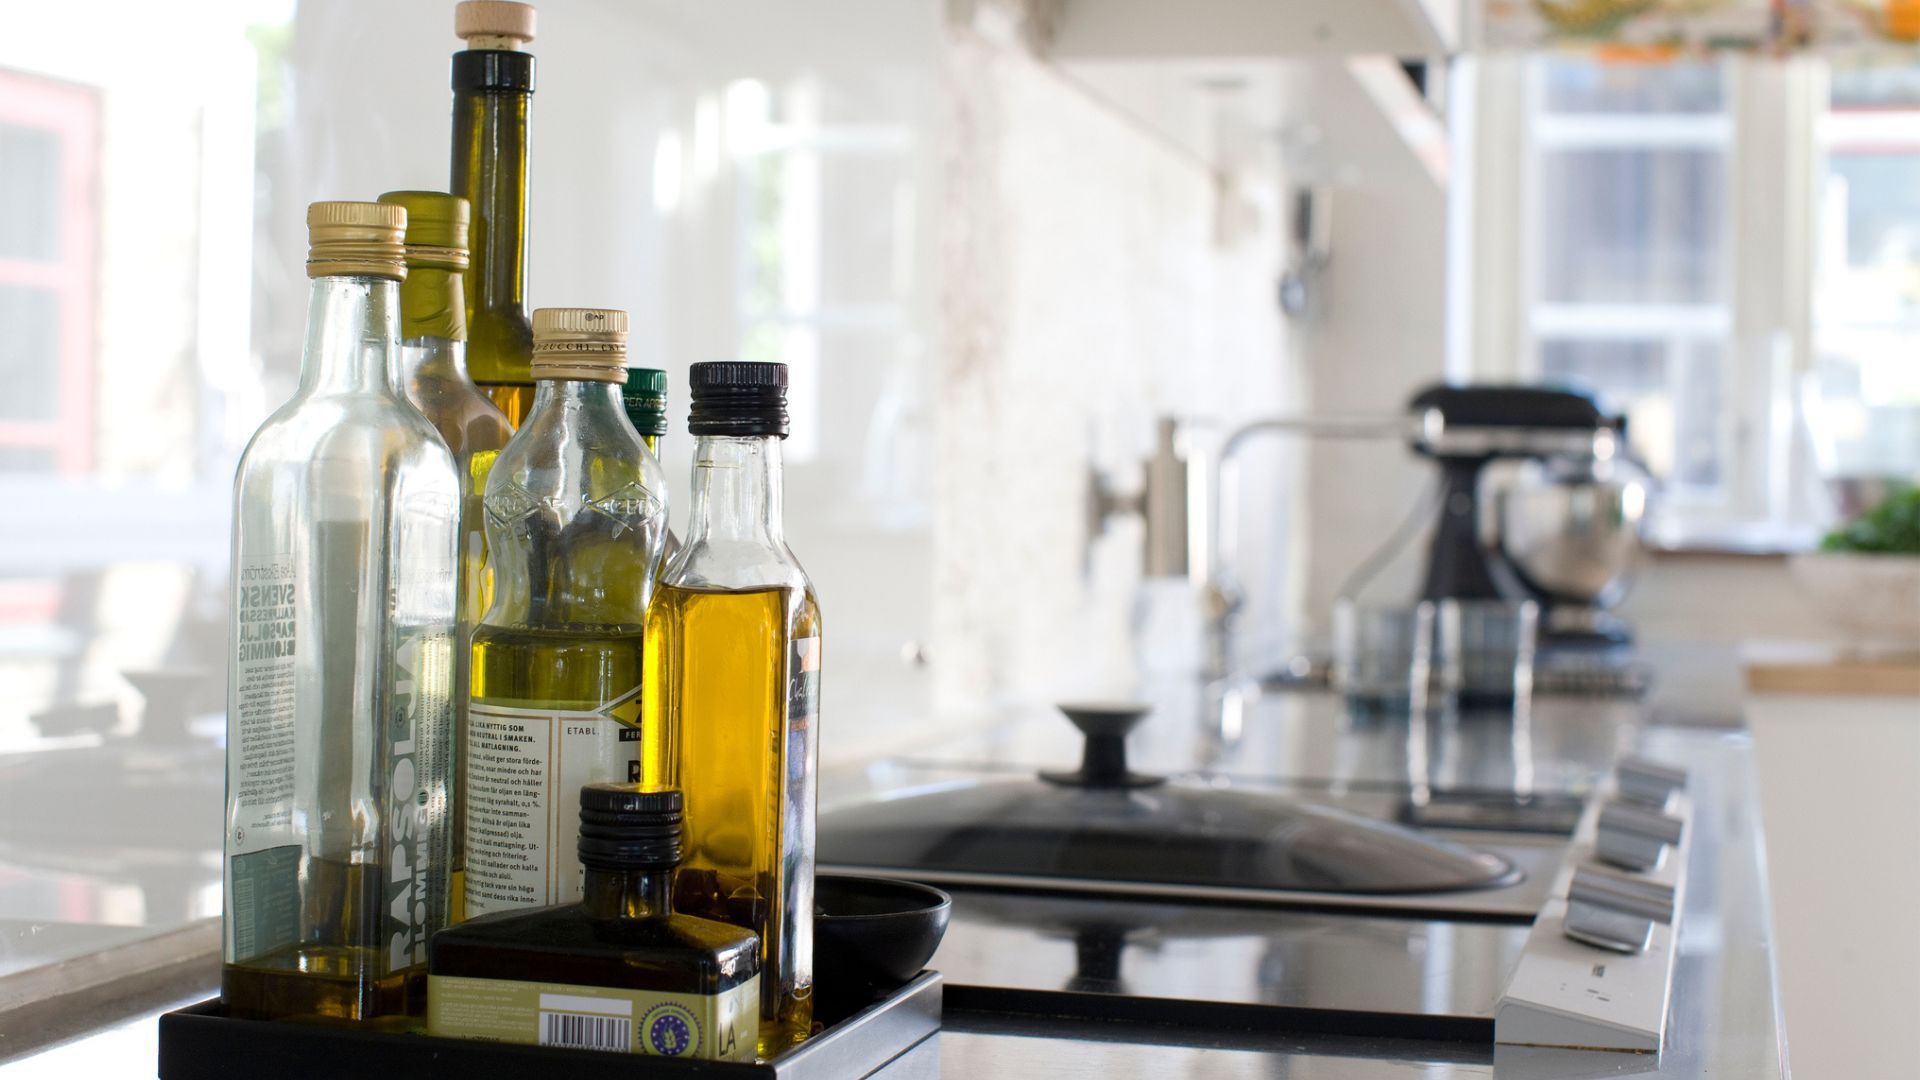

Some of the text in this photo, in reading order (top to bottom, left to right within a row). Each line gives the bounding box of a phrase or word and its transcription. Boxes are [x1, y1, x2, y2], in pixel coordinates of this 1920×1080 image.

[486, 723, 507, 731] NYTTIG
[477, 732, 498, 740] NEUTRAL
[482, 743, 521, 752] MATLAGNING.
[496, 756, 506, 764] ger
[523, 757, 542, 765] förde-
[499, 788, 512, 796] oljan
[390, 632, 417, 972] RAPSOLJA
[503, 820, 517, 828] oljan
[488, 861, 508, 869] sallader
[414, 807, 429, 965] BLOMMIG
[518, 885, 534, 894] höga
